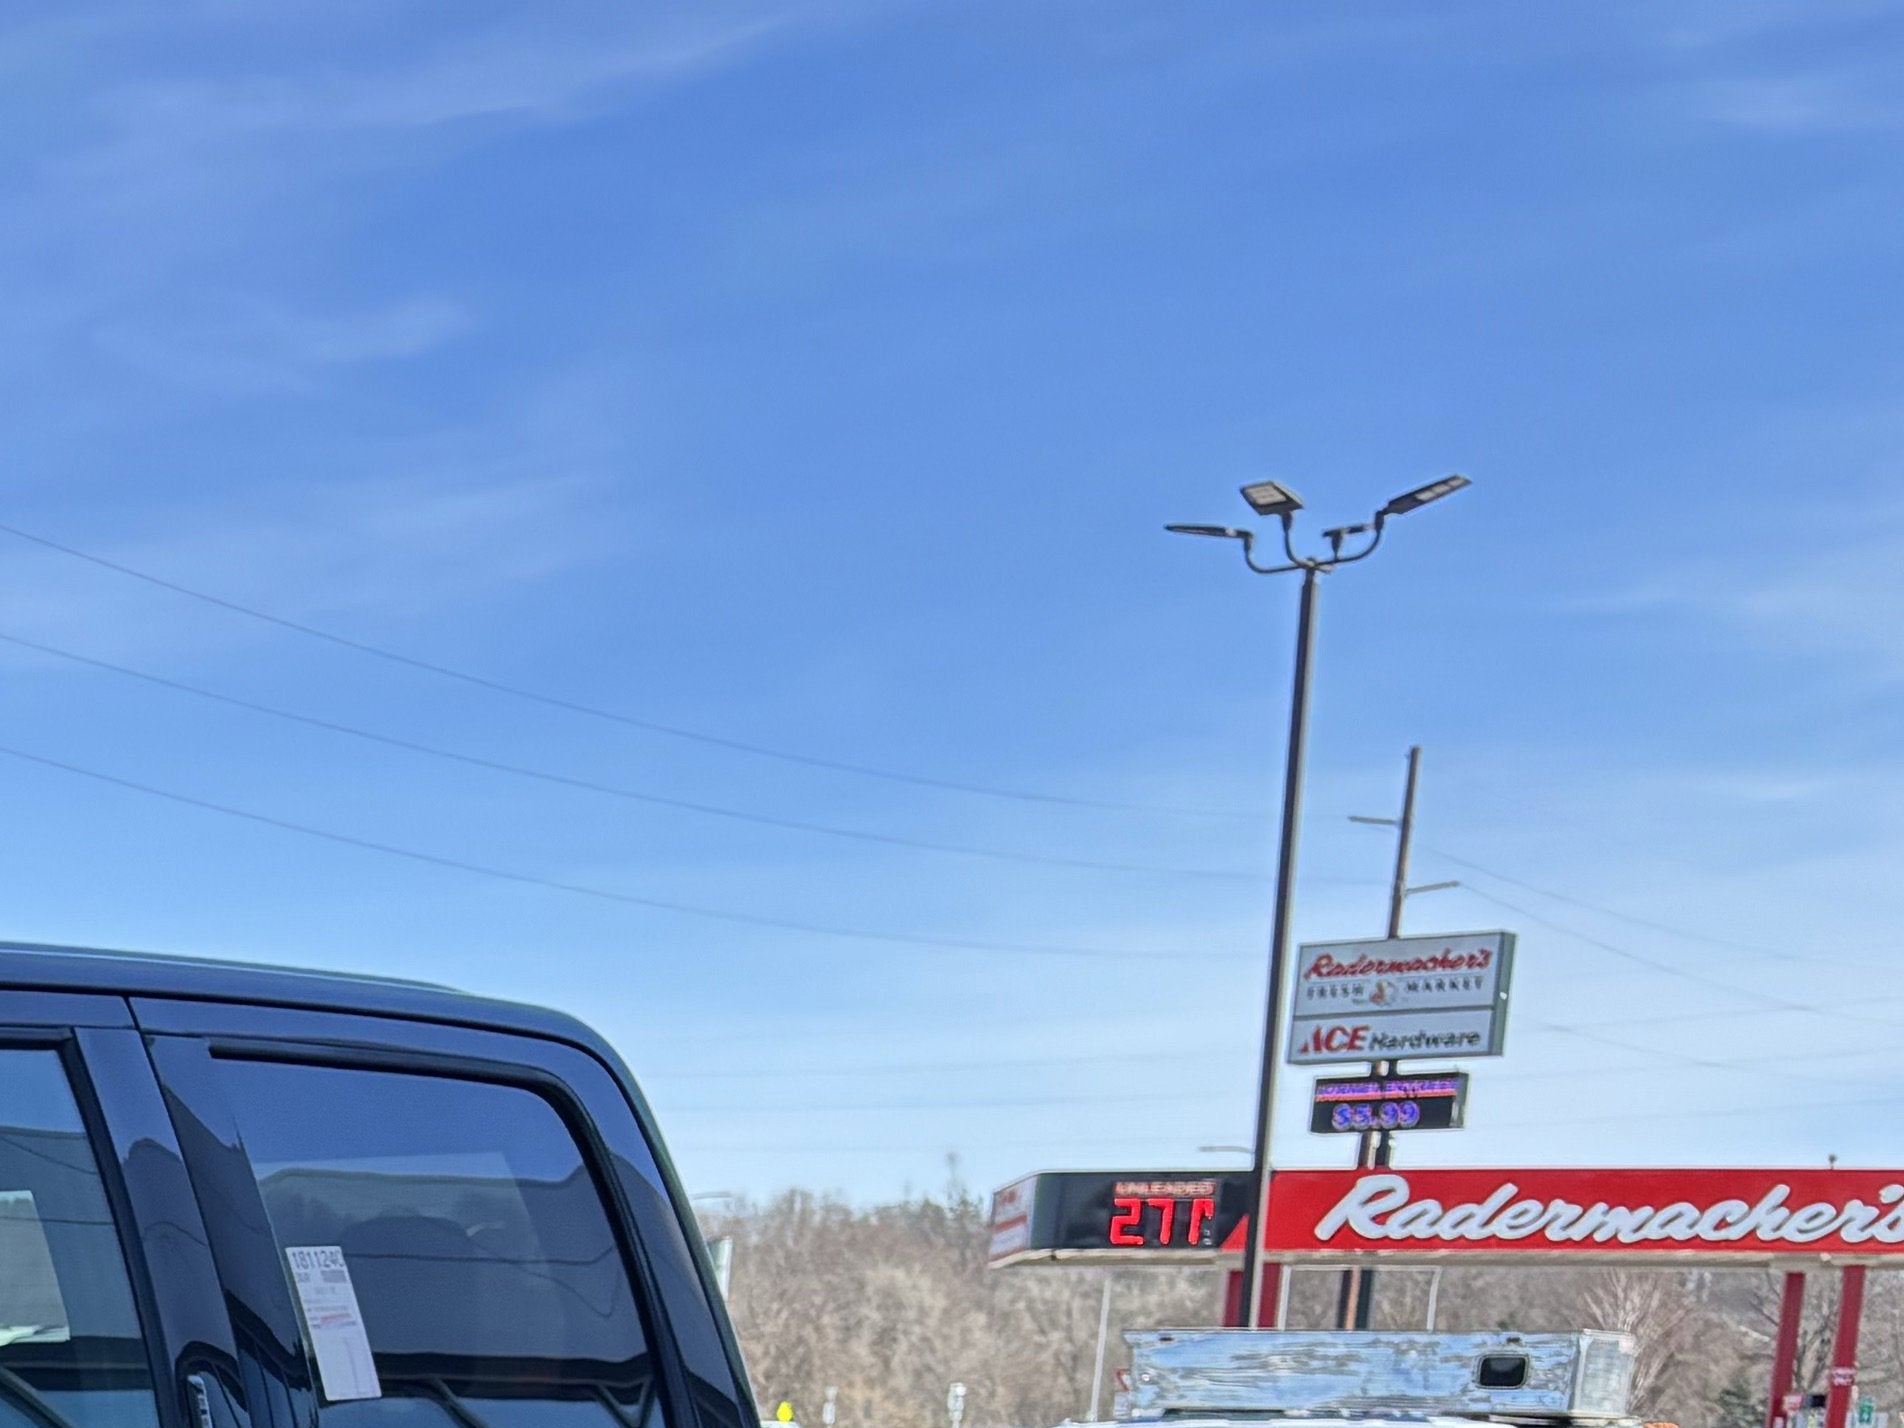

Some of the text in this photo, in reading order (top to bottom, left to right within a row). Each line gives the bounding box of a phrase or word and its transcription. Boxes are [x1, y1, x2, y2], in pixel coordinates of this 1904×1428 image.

[1298, 1024, 1481, 1055] ACE Hardware
[1314, 1173, 1904, 1245] Radermacher's
